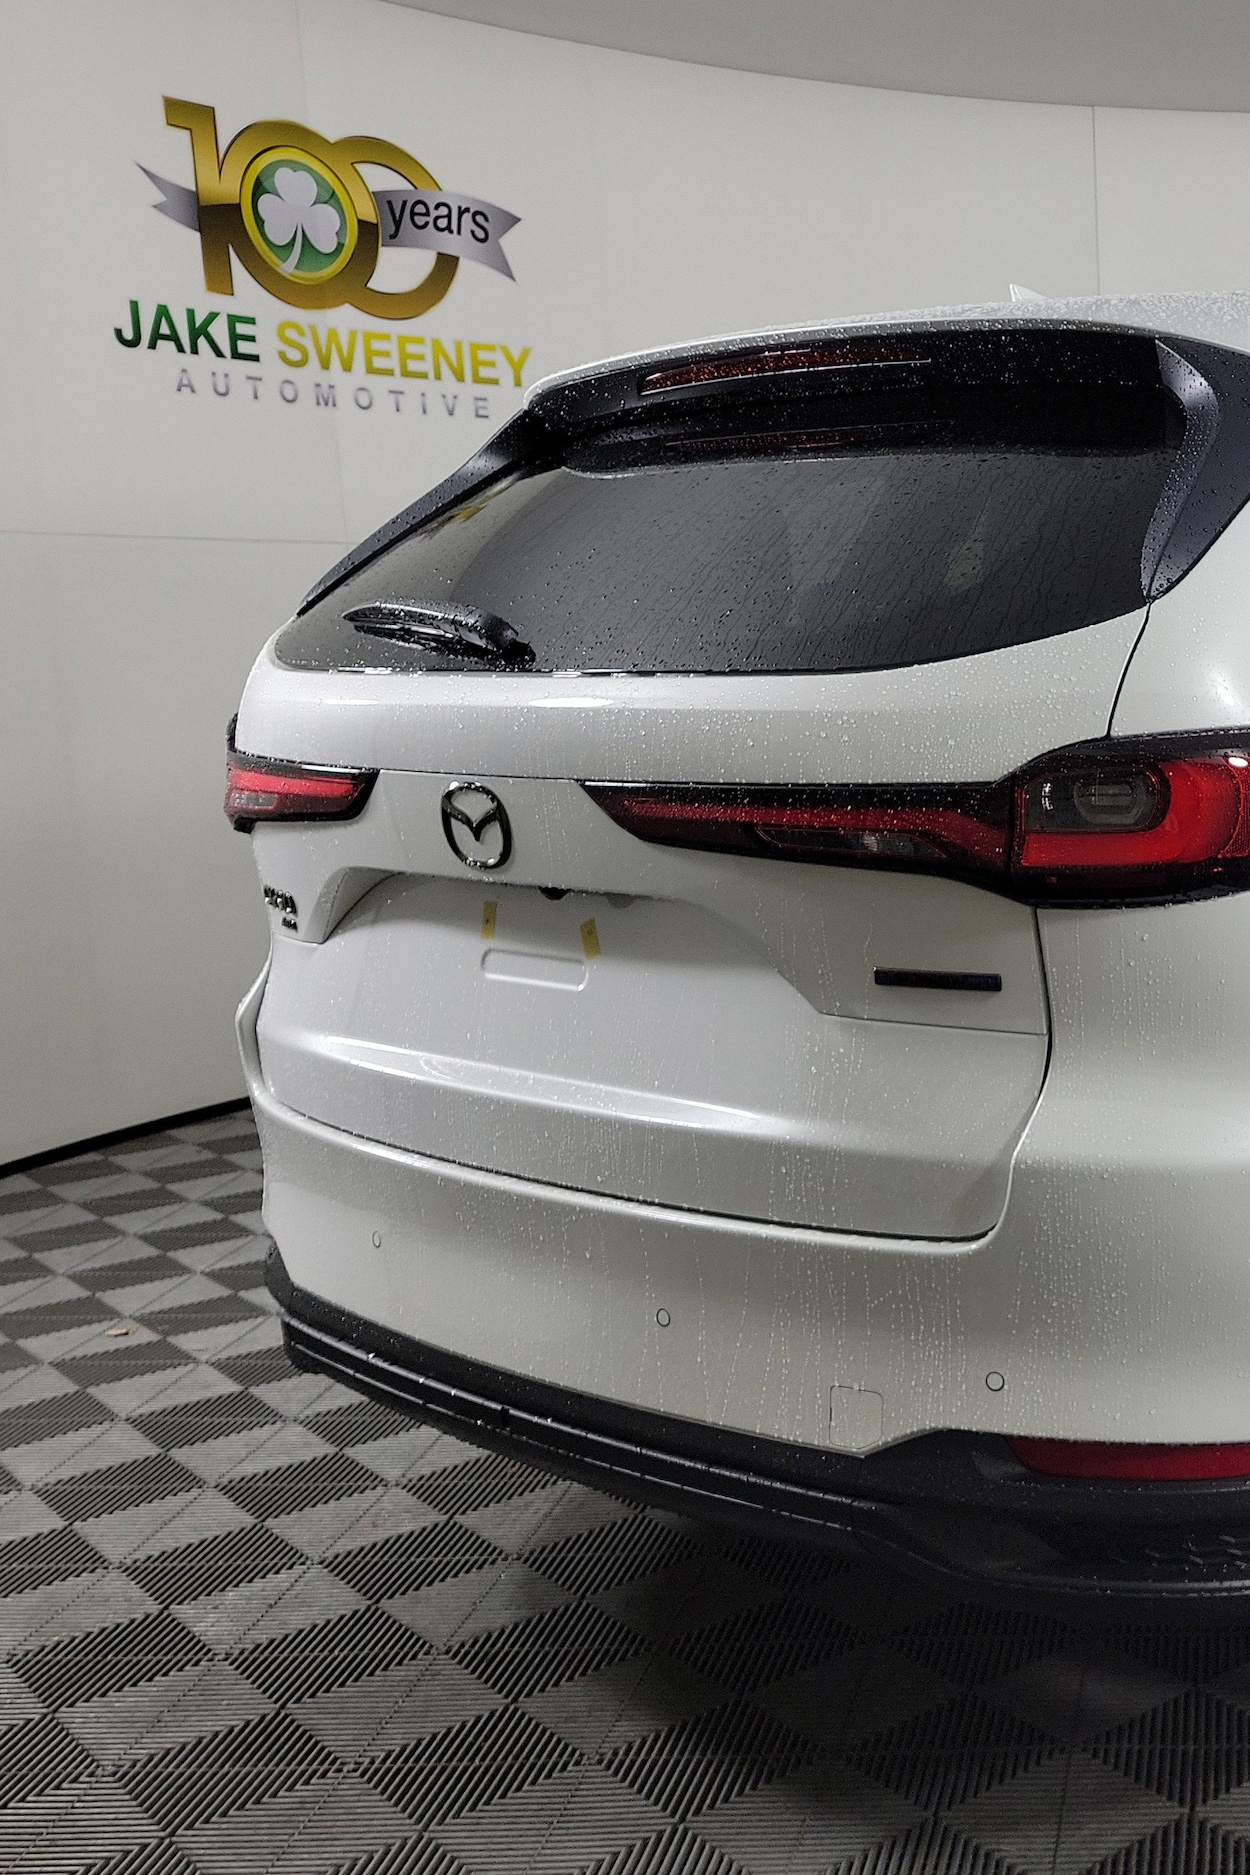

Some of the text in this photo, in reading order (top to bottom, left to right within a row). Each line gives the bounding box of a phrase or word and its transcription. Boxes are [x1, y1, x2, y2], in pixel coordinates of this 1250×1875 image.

[161, 95, 491, 320] 100 years
[113, 299, 533, 388] JAKE SWEENEY
[175, 368, 490, 419] AUTOMOTIVE
